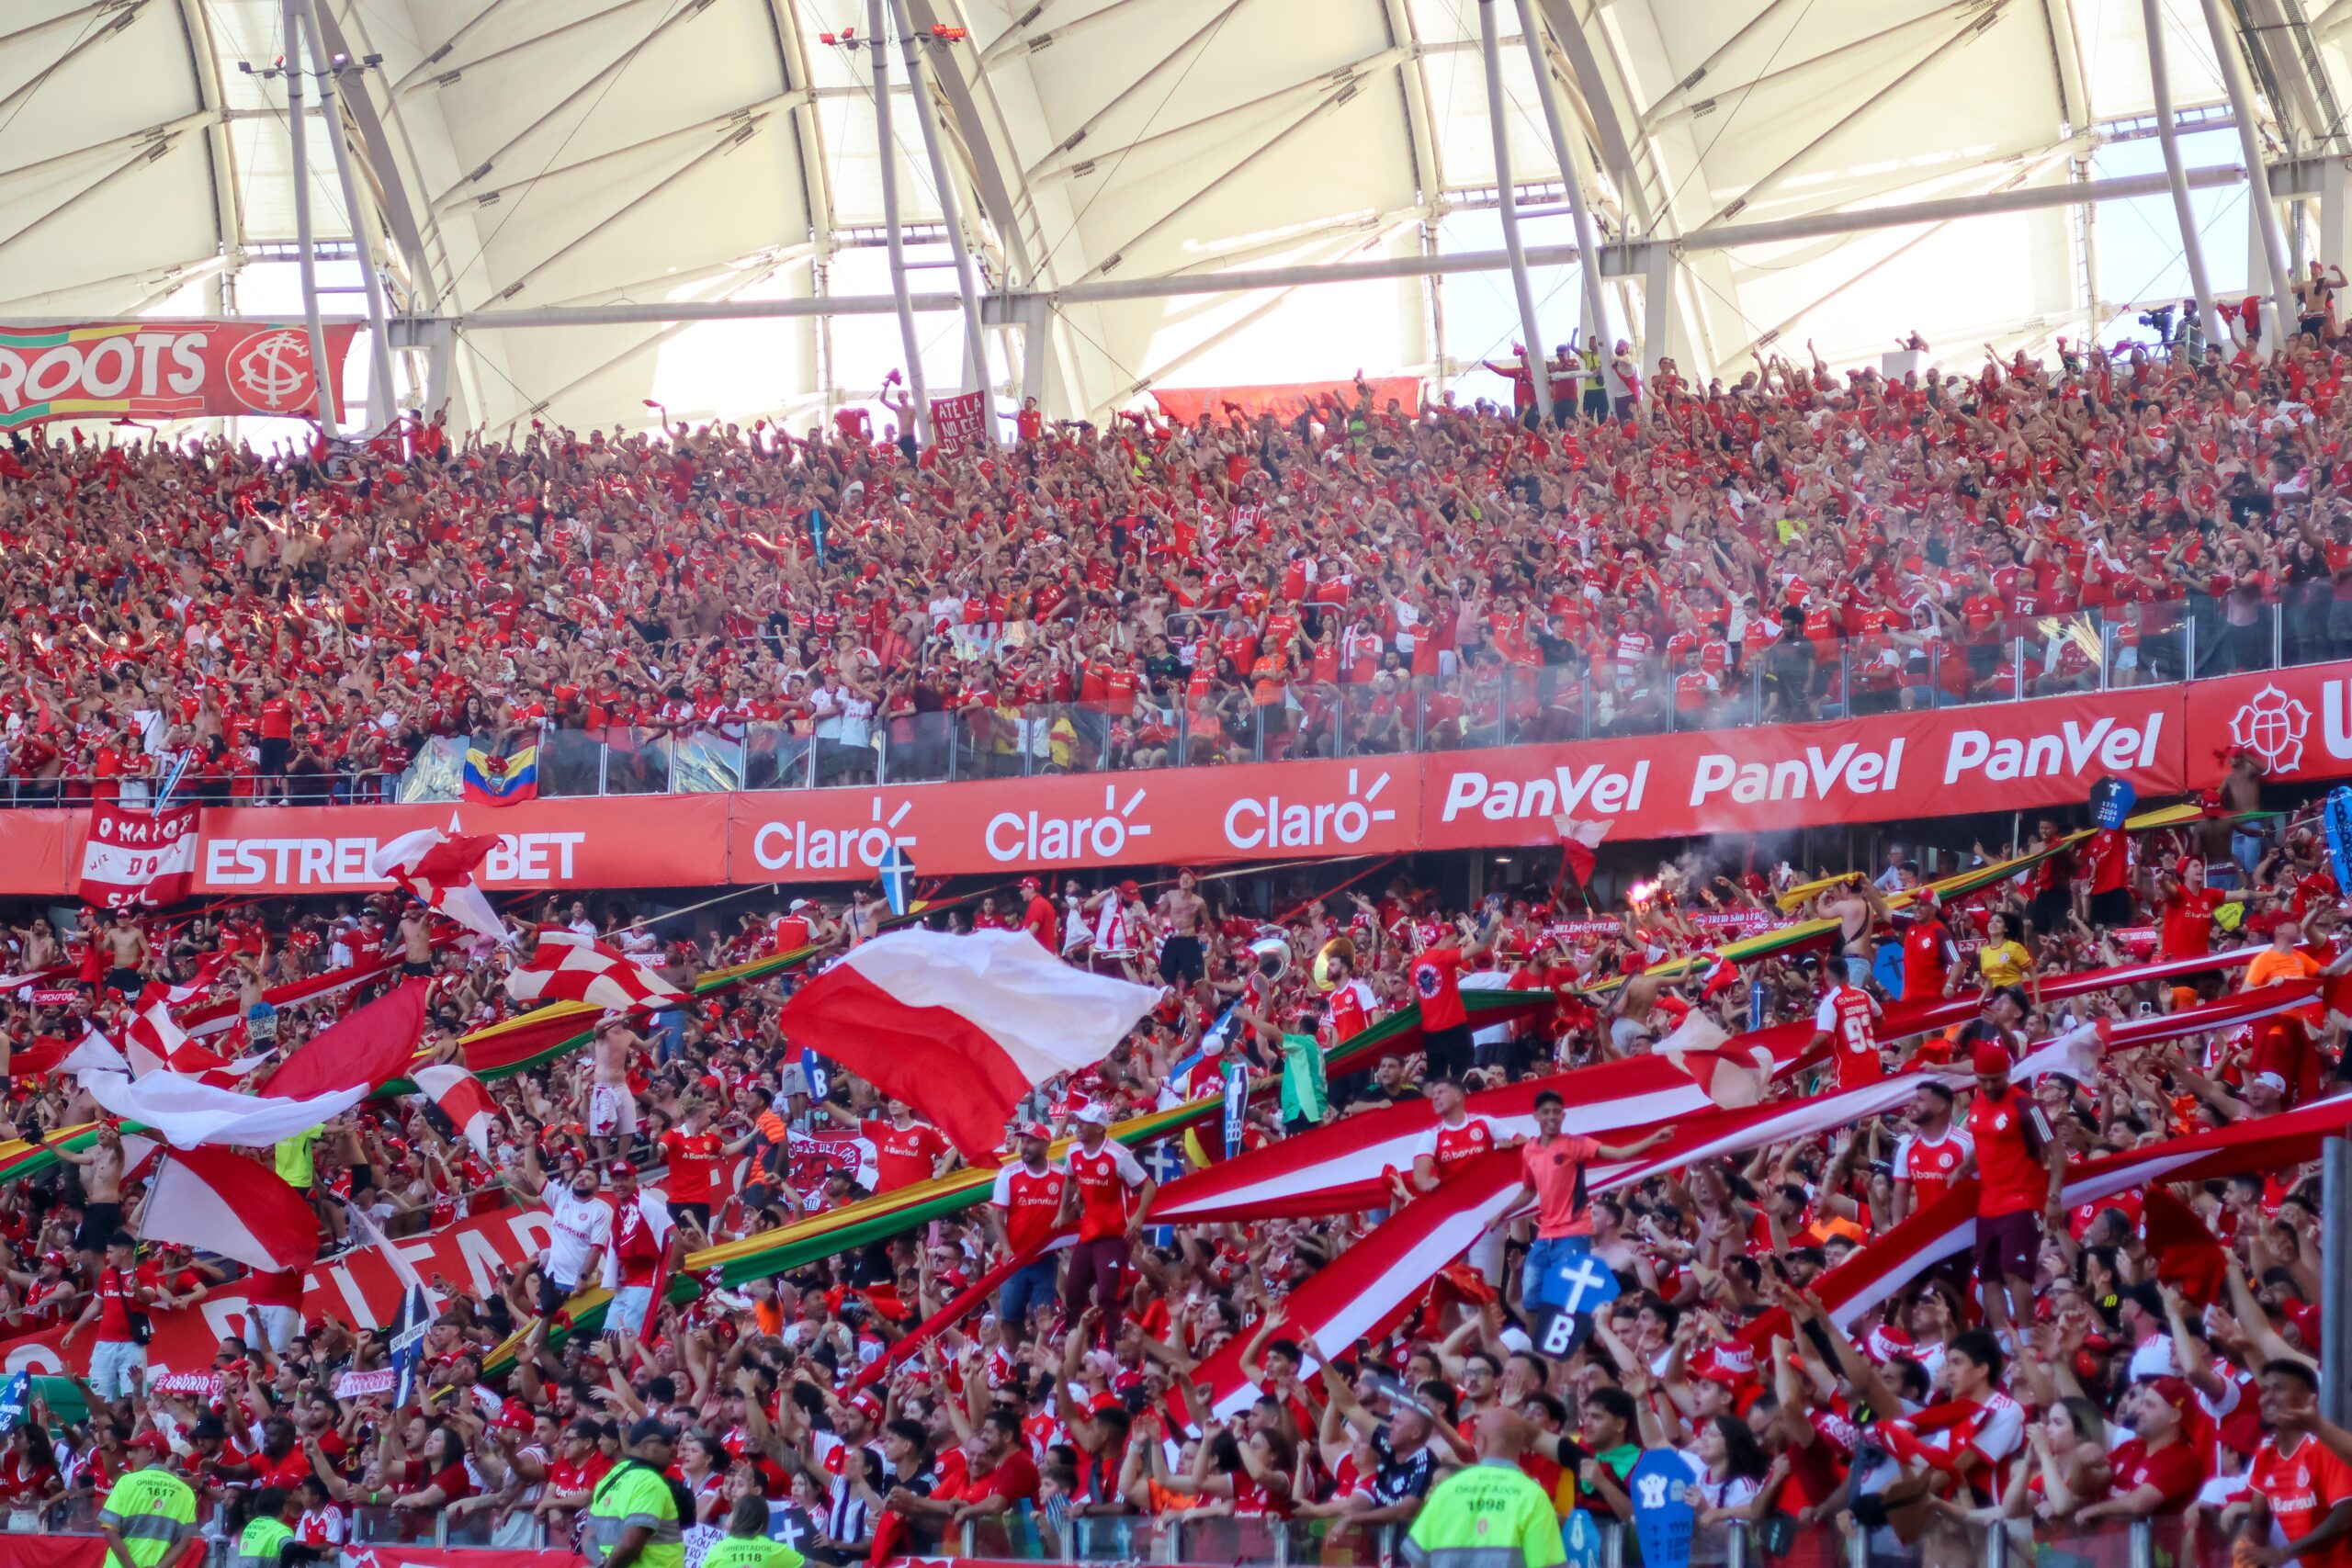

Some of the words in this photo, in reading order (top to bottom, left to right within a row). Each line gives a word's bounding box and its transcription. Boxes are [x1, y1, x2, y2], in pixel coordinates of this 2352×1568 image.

[939, 399, 961, 420] ATÉ
[941, 421, 958, 437] NO
[1944, 713, 2165, 784] PanVel
[1442, 761, 1651, 822] PanVel
[1690, 738, 1905, 807] PanVel
[986, 799, 1137, 862] Claro
[1225, 784, 1381, 850] Claro
[754, 809, 904, 870] Claro
[127, 855, 158, 875] DO
[1844, 1014, 1877, 1054] 93
[814, 1068, 827, 1099] B
[1544, 1314, 1576, 1354] B
[137, 1478, 183, 1492] ORIENTADOR
[147, 1486, 175, 1498] 1617
[731, 1552, 763, 1562] 1118
